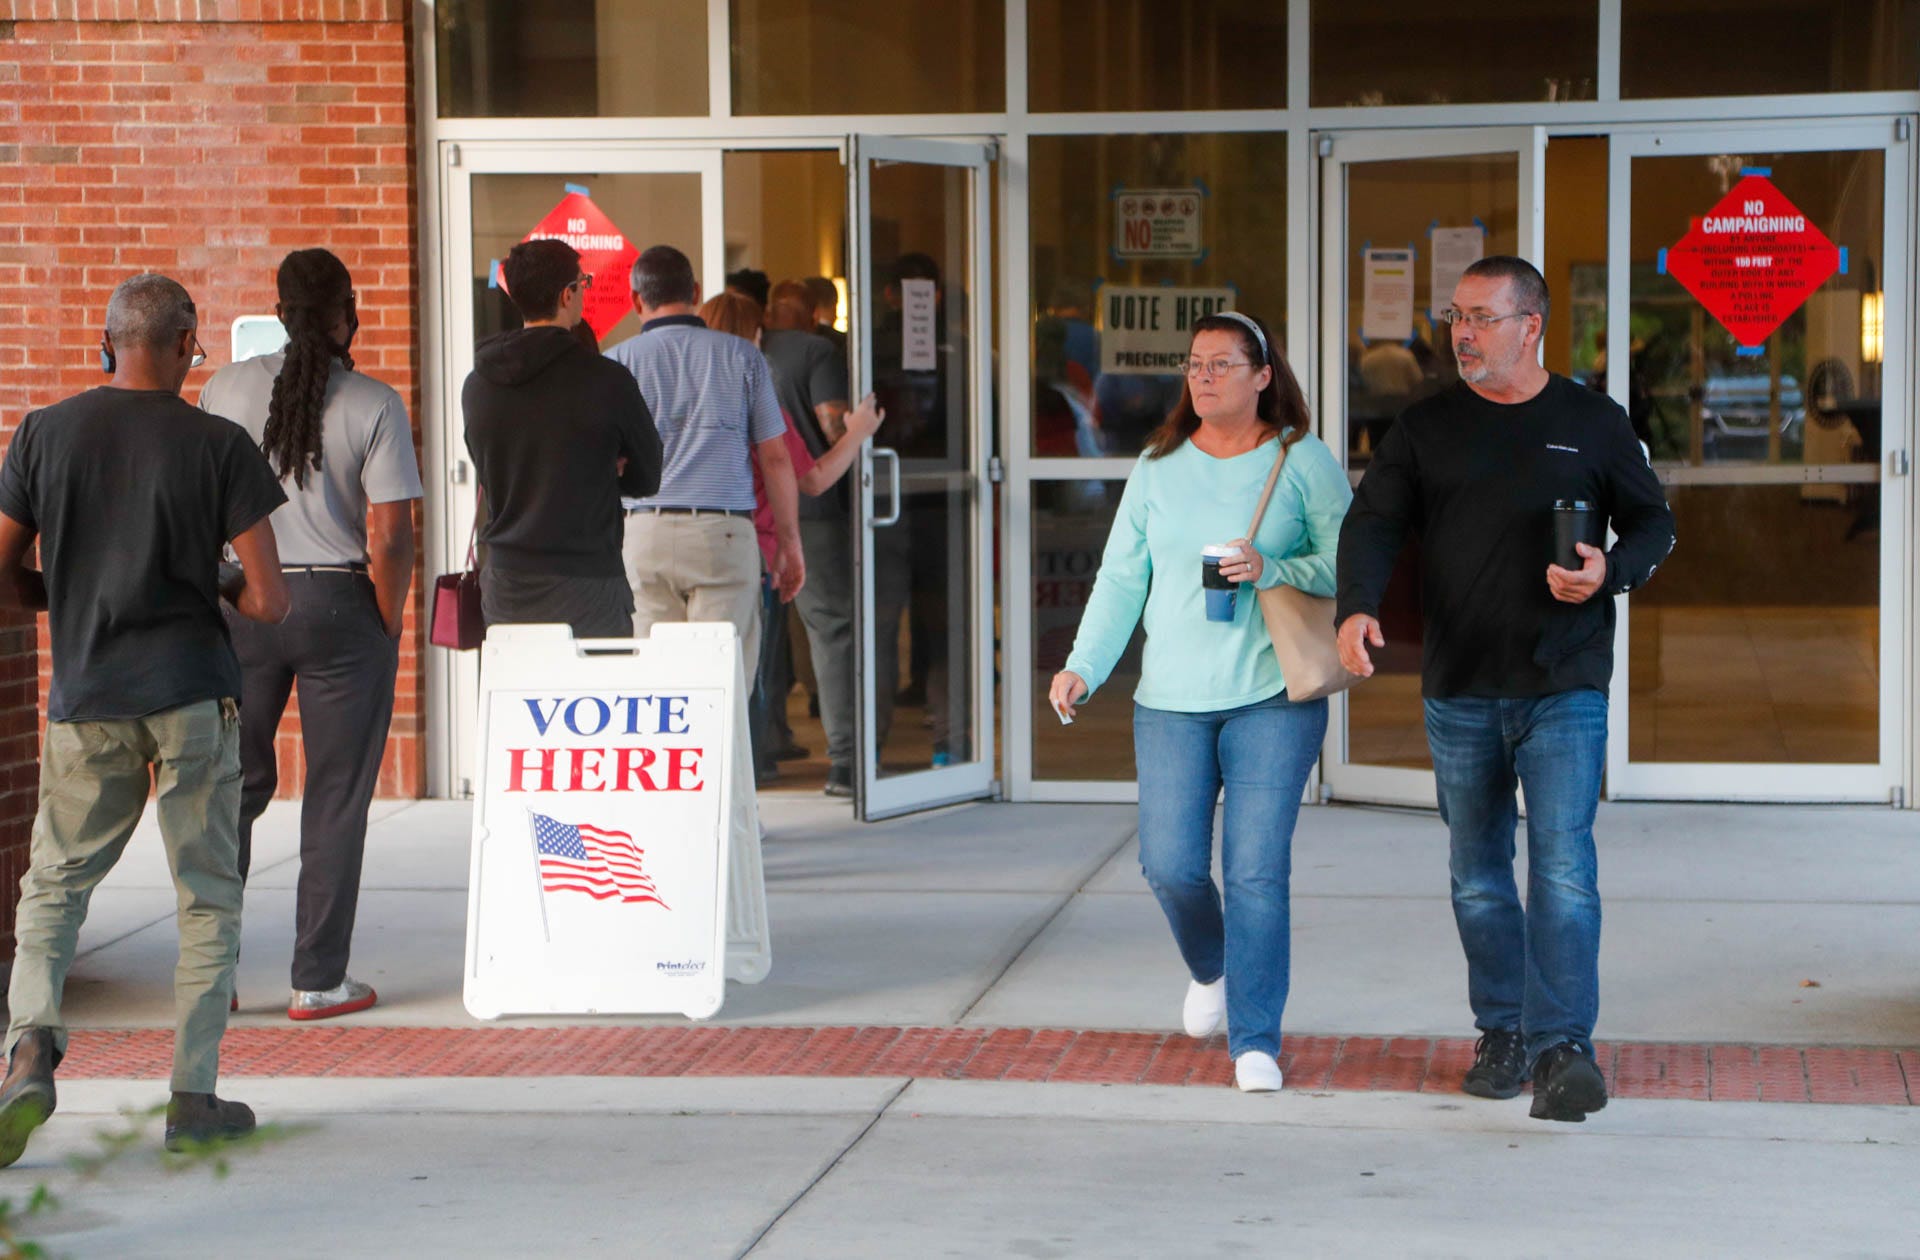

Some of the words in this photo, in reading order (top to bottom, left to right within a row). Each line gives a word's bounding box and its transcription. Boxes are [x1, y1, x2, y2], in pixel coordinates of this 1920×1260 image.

[1744, 200, 1764, 216] NO
[567, 217, 587, 233] NO
[1703, 216, 1805, 233] CAMPAIGNING
[1125, 219, 1152, 250] NO
[1703, 258, 1733, 266] WITHIN
[1752, 257, 1773, 267] FEET
[1777, 280, 1805, 288] WHICH
[598, 296, 624, 304] WHICH
[1734, 303, 1759, 311] PLACE
[1762, 303, 1771, 311] IS
[1110, 295, 1160, 330] VOTE
[523, 695, 690, 736] VOTE
[504, 747, 704, 793] HERE
